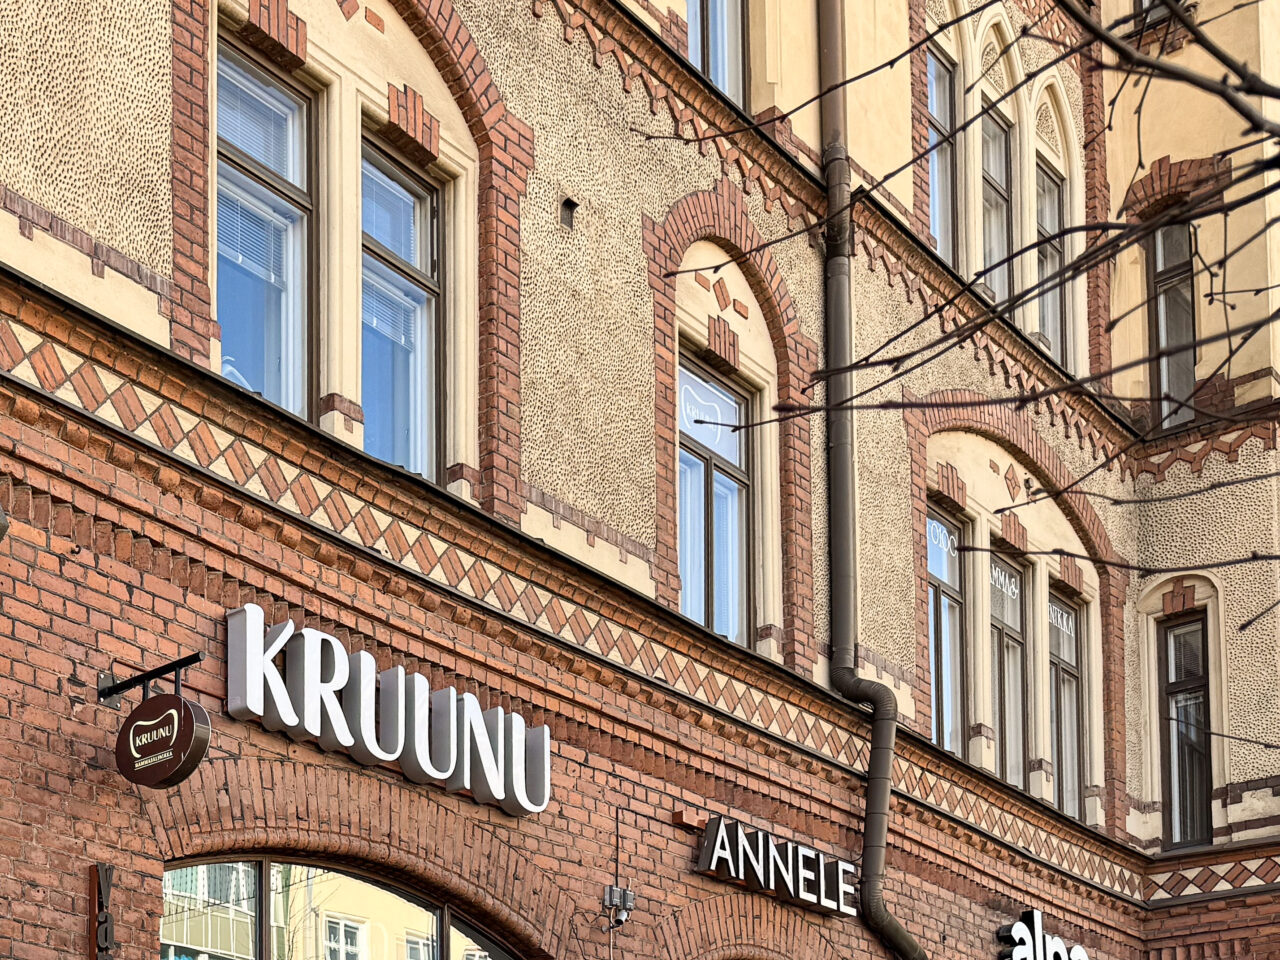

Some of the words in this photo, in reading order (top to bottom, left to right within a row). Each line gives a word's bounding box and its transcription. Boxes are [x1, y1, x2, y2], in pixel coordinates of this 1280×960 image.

[135, 724, 173, 747] KRUUNU
[230, 602, 551, 814] KRUUNU
[709, 815, 858, 917] ANNELE
